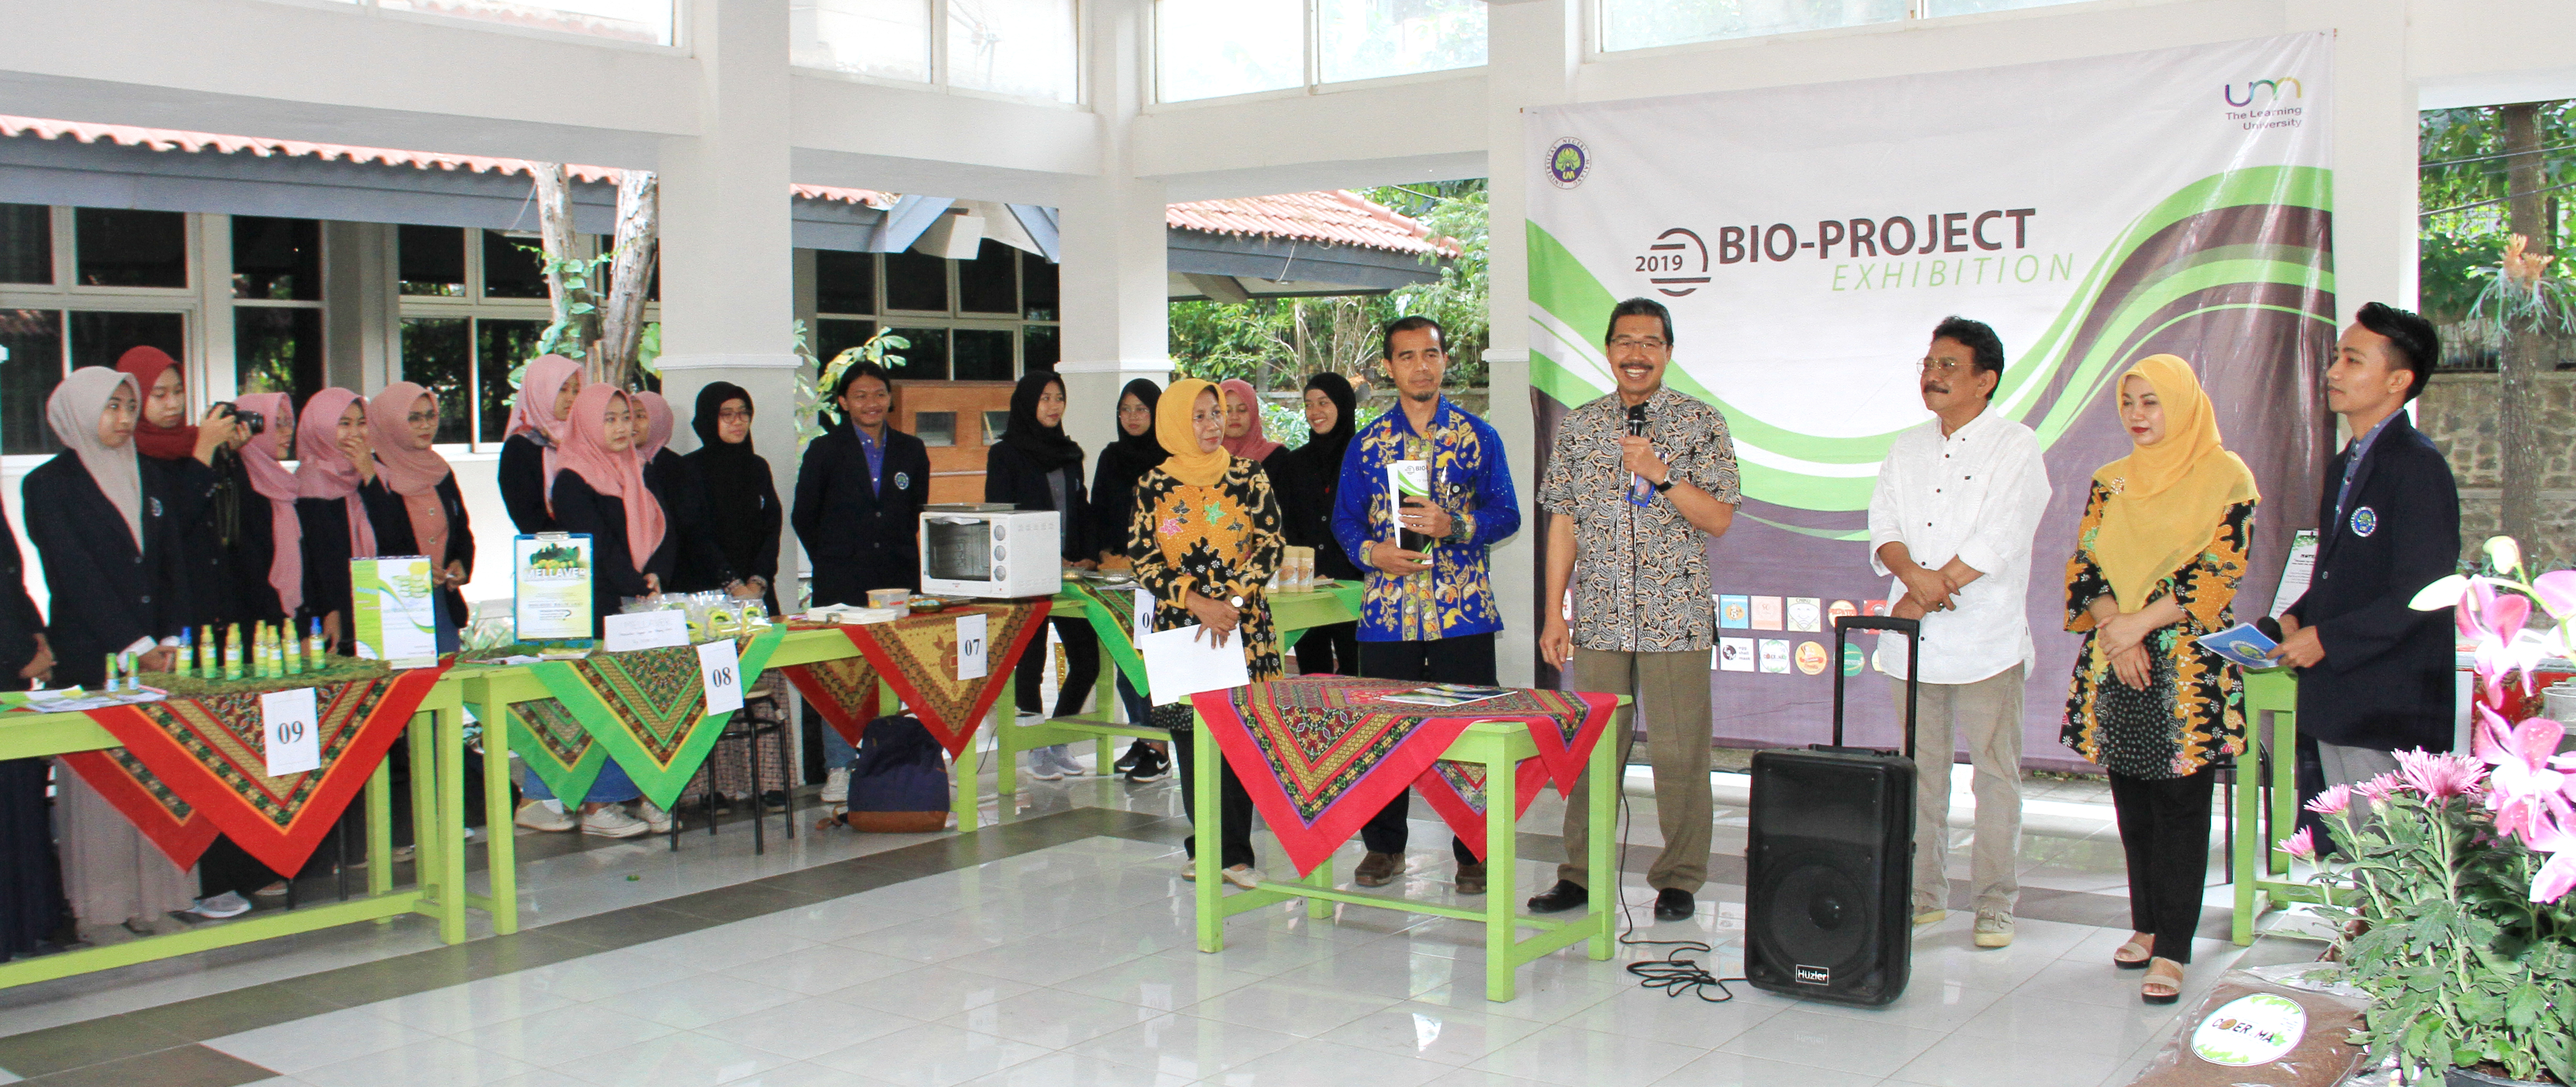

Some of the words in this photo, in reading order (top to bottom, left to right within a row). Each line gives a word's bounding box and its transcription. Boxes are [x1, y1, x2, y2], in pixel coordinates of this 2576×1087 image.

[2226, 112, 2247, 120] The
[2250, 107, 2302, 118] Learning
[2244, 119, 2302, 130] University
[1563, 139, 1585, 151] NEGERI
[1562, 170, 1575, 180] UM
[1573, 159, 1590, 185] MALANG
[1719, 208, 2036, 264] BIO-PROJECT
[1635, 254, 1683, 272] 2019
[1832, 253, 2073, 291] EXHIBITION
[965, 638, 980, 656] 07
[713, 667, 731, 687] 08
[277, 720, 304, 744] 09
